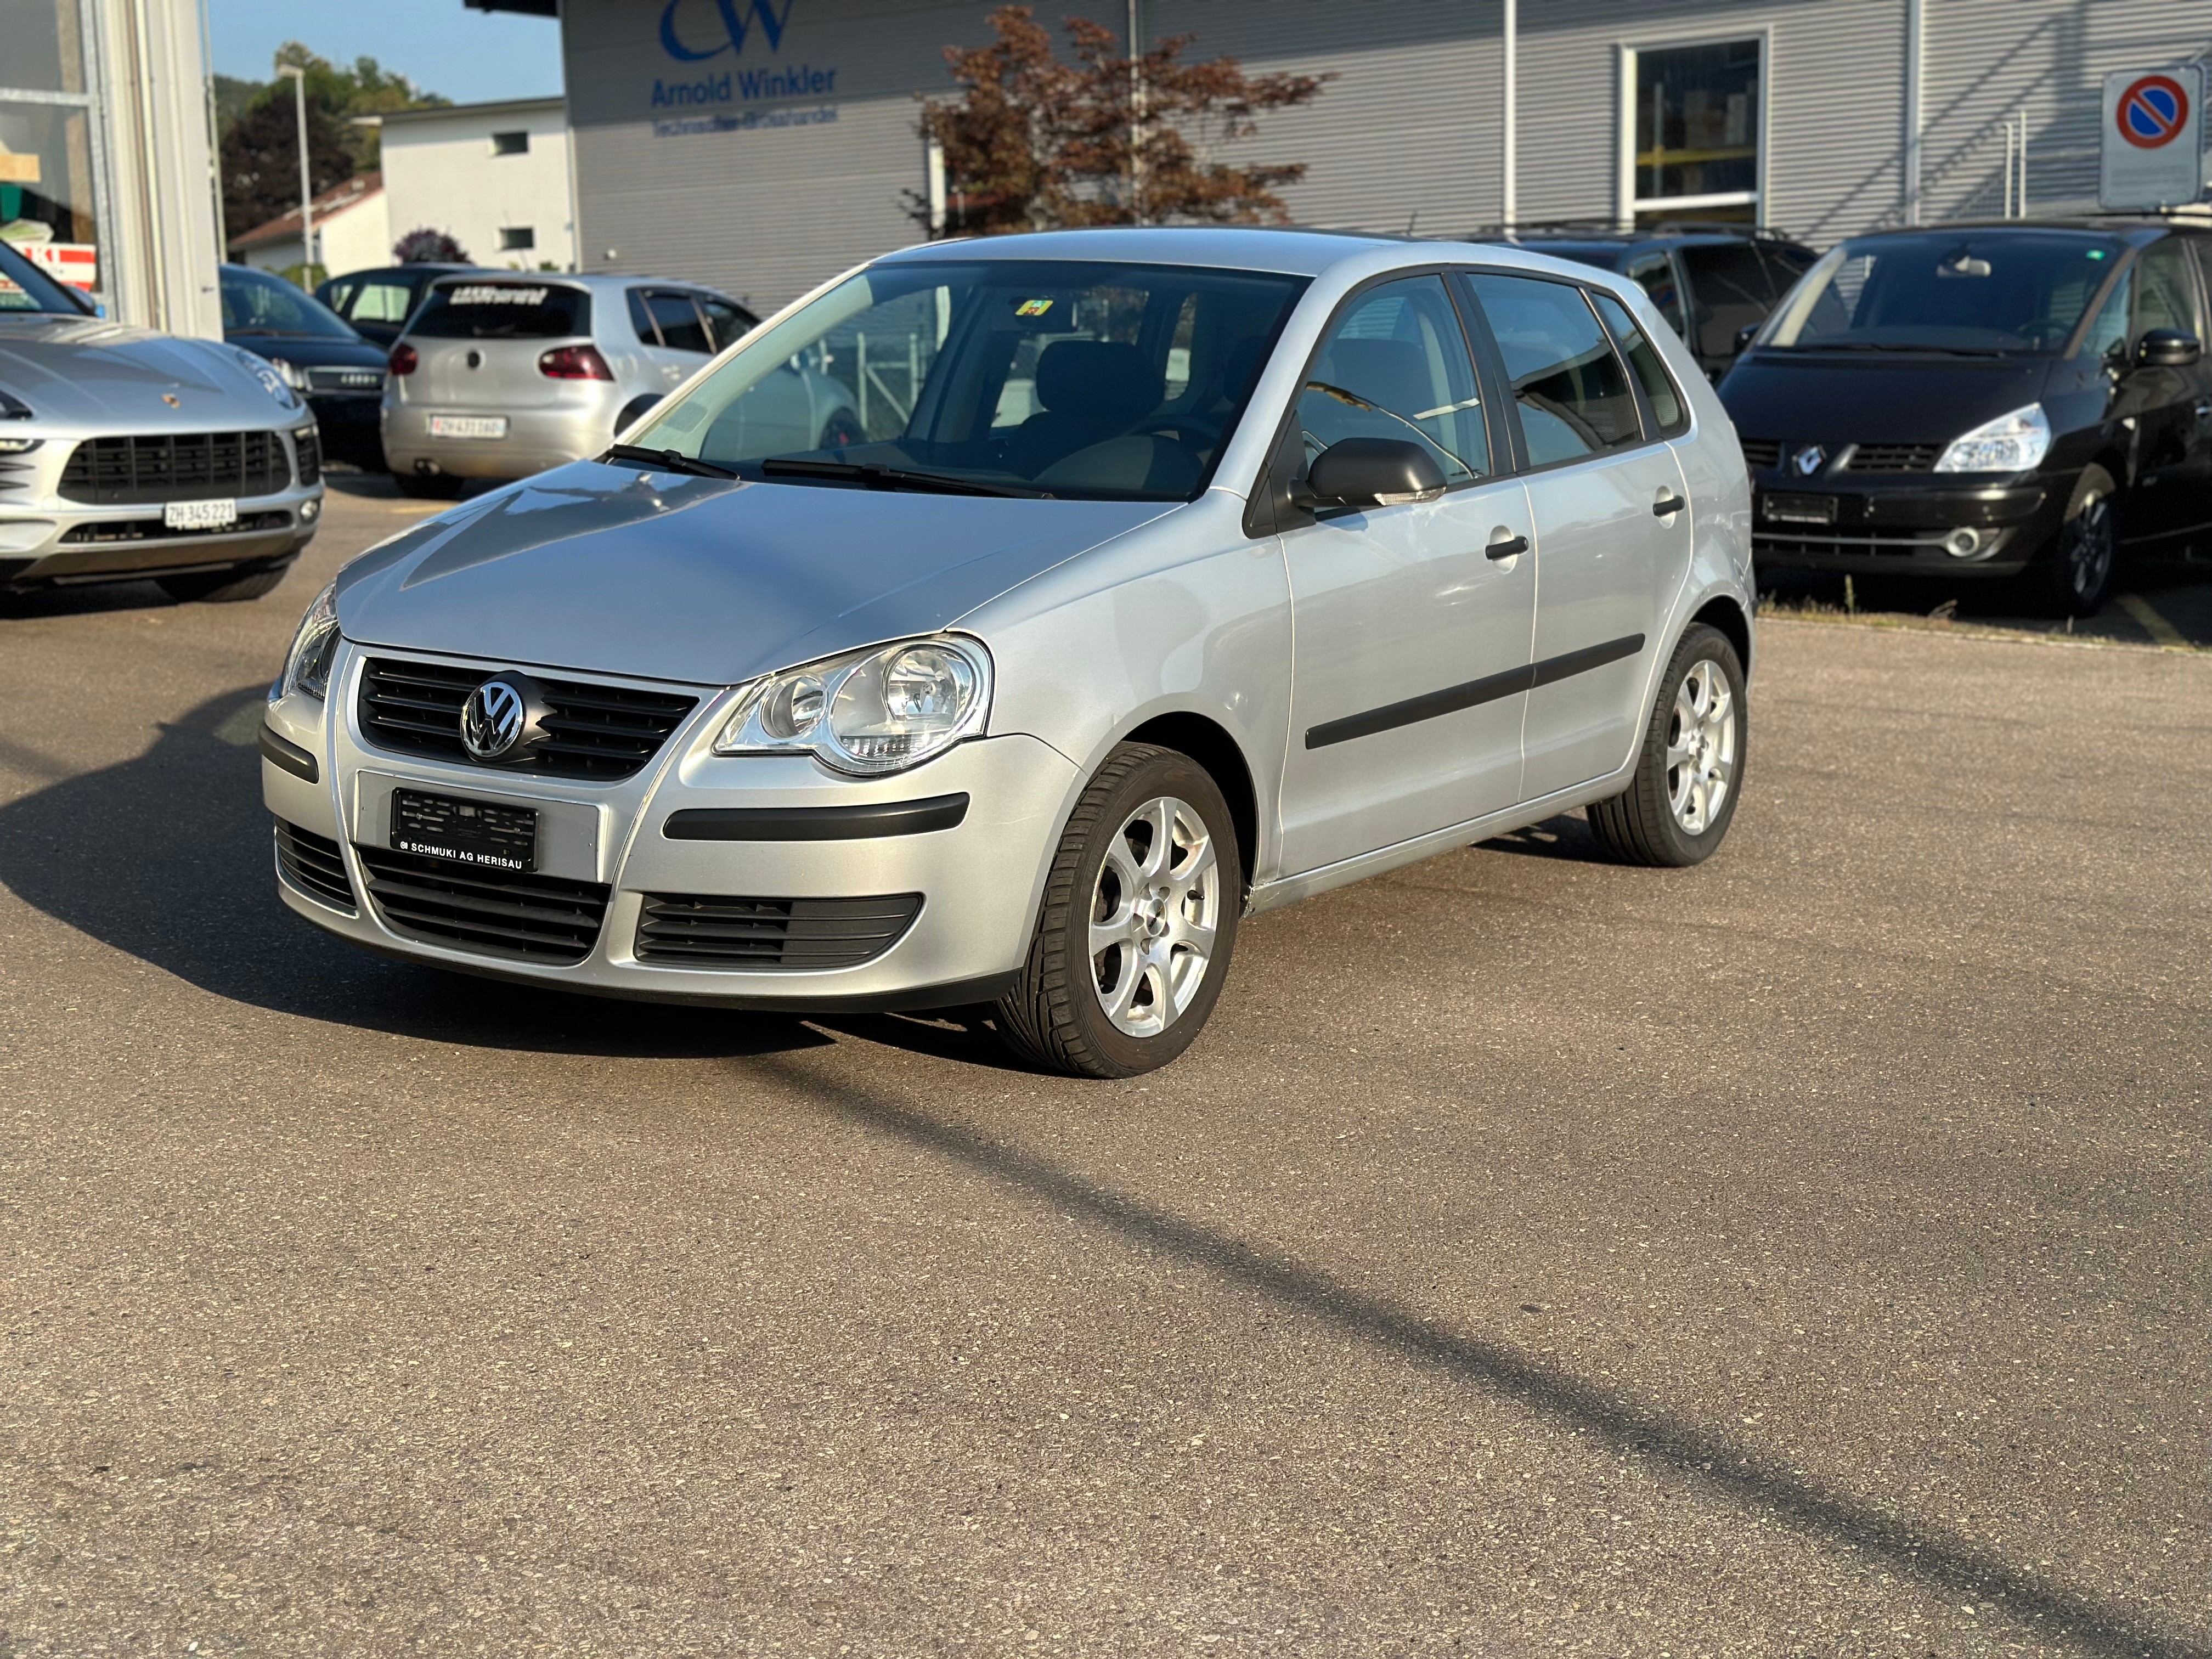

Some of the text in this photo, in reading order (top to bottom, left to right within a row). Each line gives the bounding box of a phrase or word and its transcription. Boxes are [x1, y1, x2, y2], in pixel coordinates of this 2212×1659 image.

[651, 64, 837, 108] Arnold Winkler
[168, 506, 184, 523] ZH
[411, 843, 522, 869] SCHMUKI AG HERISAU
